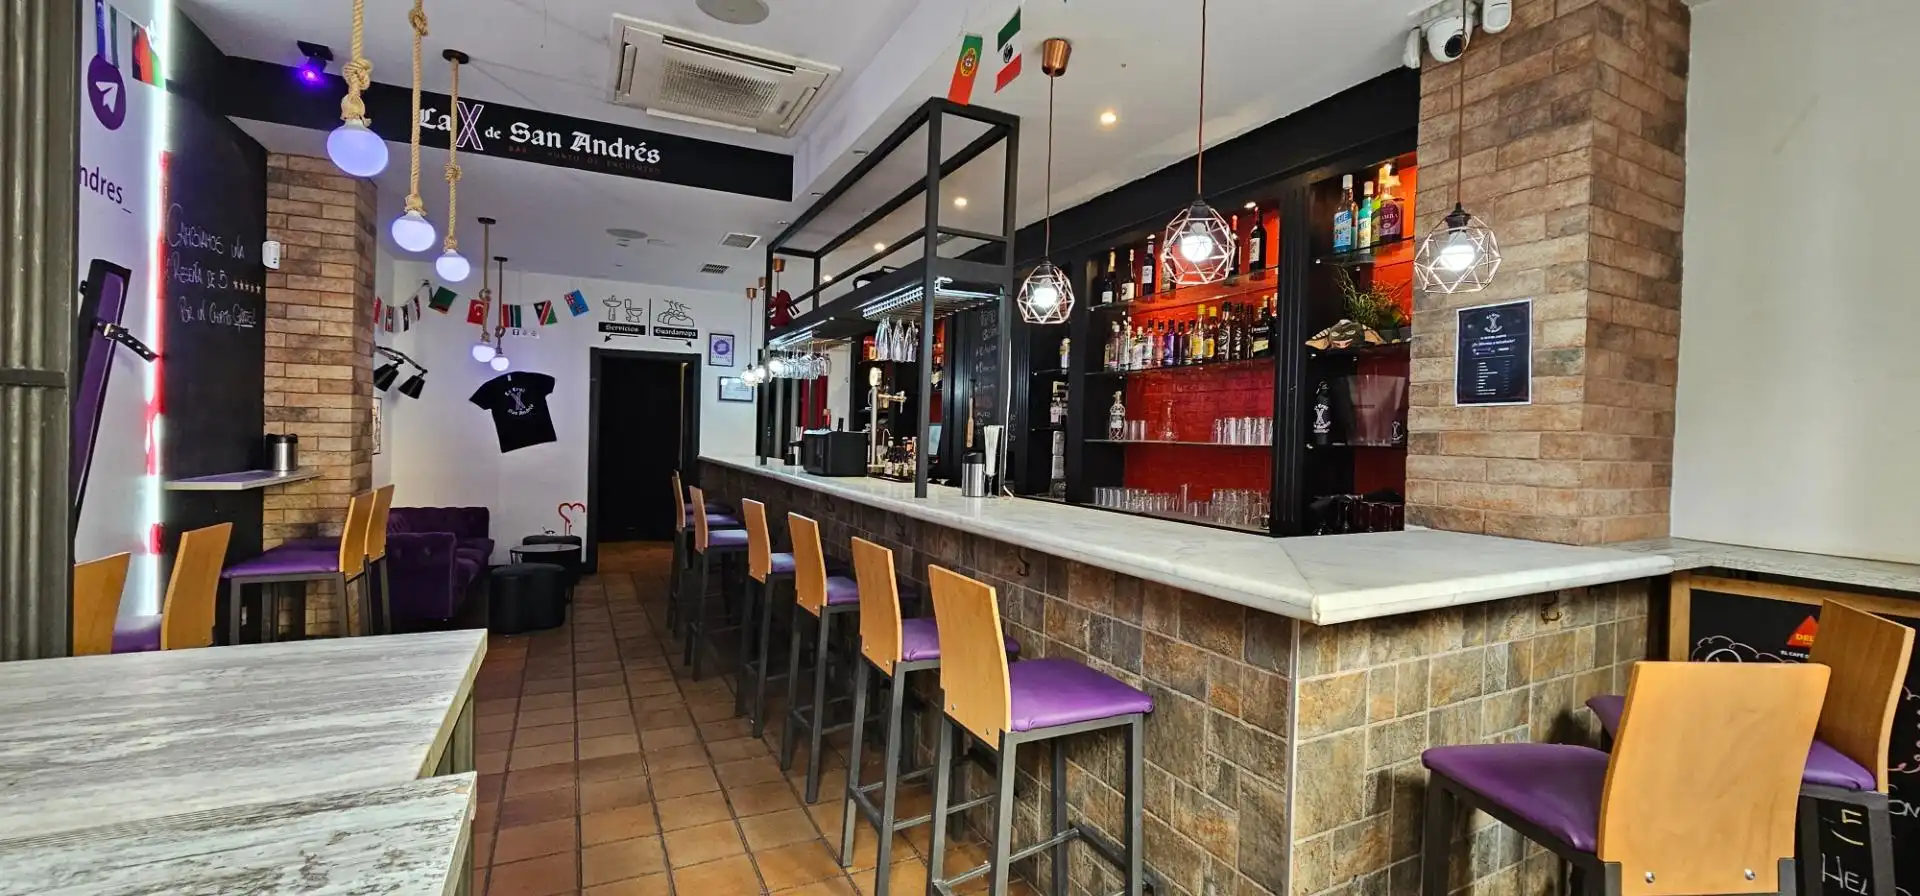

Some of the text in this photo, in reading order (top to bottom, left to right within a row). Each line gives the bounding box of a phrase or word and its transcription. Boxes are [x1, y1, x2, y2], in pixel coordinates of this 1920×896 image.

[419, 107, 451, 131] La
[485, 126, 502, 139] de
[510, 122, 562, 149] San
[570, 131, 661, 164] Andrés
[218, 269, 228, 289] 5
[605, 324, 640, 333] Servicios
[655, 328, 697, 338] Guardarropa
